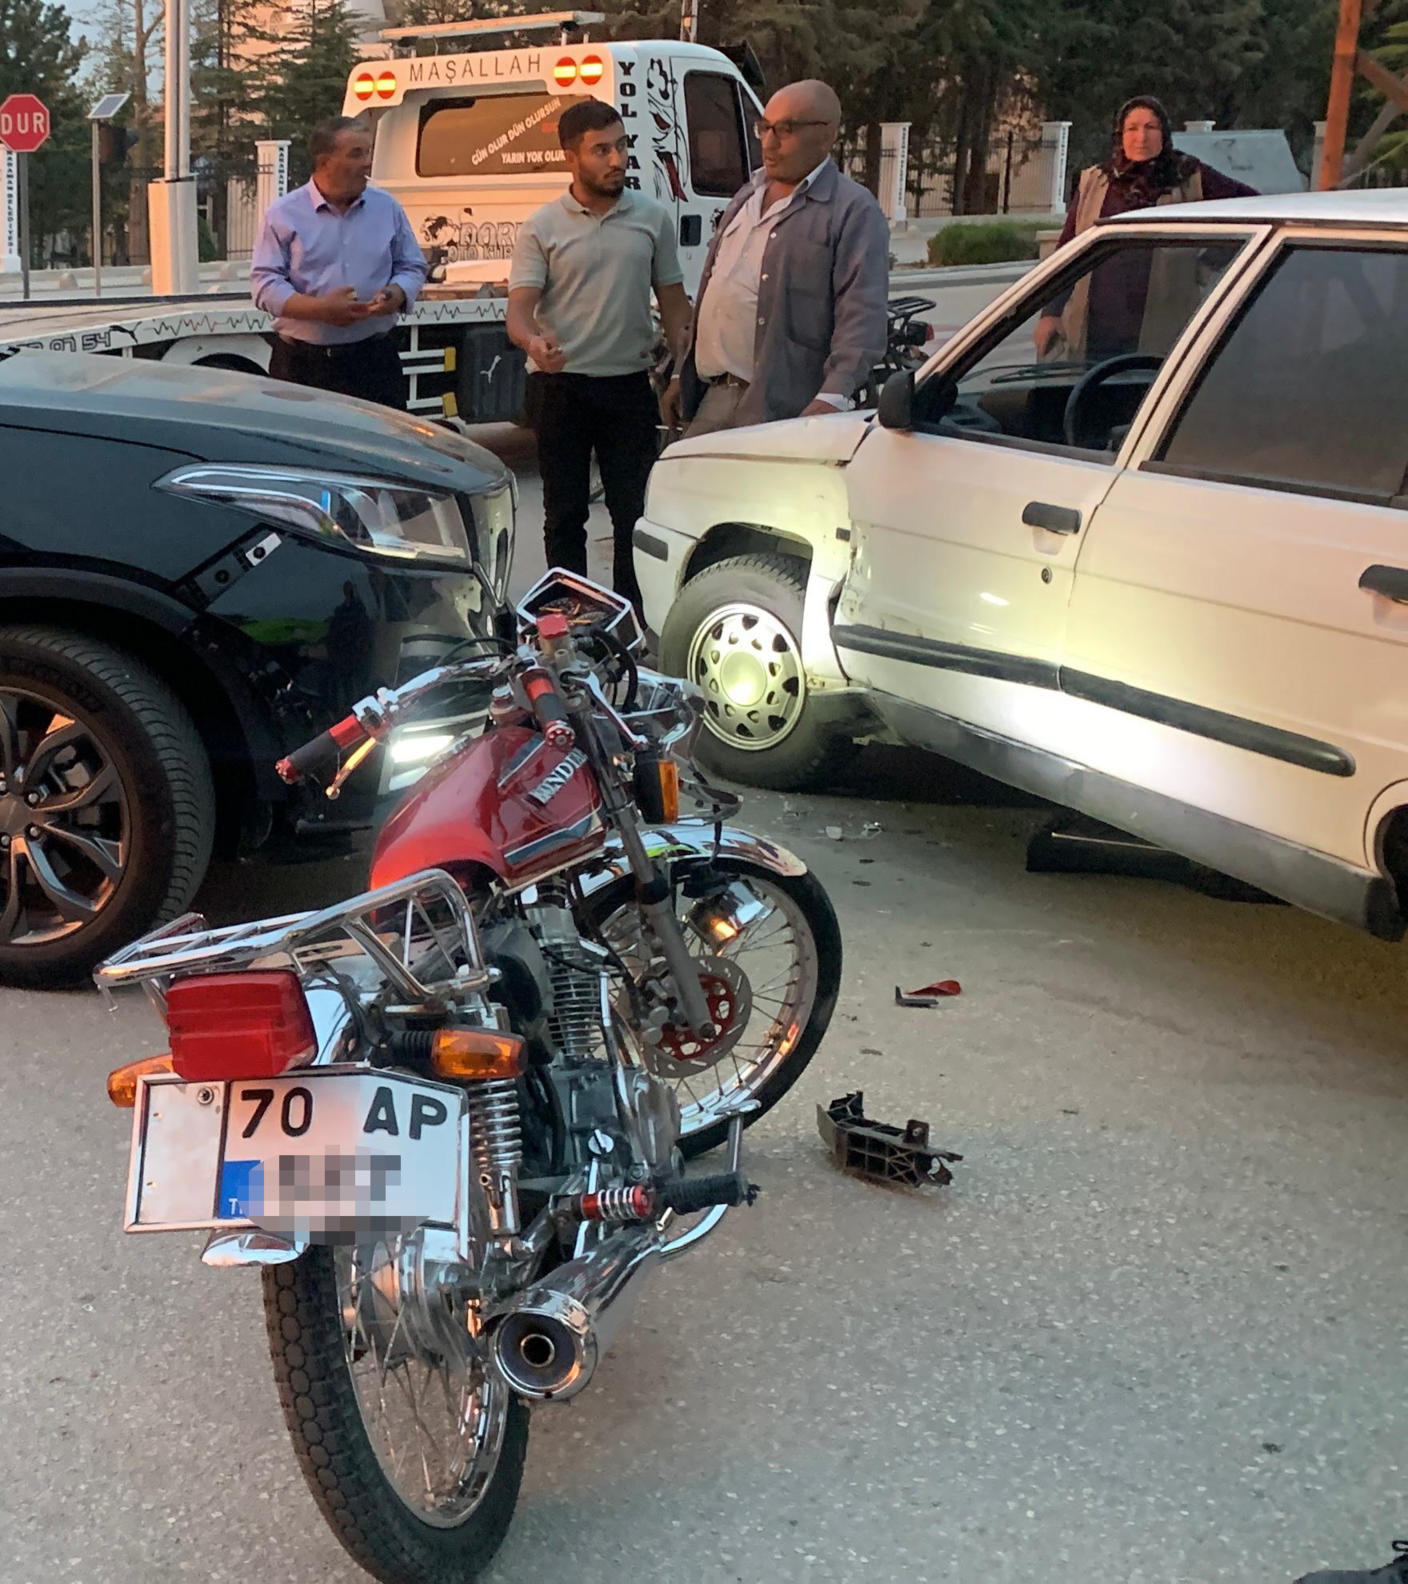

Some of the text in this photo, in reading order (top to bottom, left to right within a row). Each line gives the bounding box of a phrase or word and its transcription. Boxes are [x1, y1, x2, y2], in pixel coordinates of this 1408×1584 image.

[409, 53, 541, 84] MAŞALLAH
[617, 60, 638, 118] YOL
[0, 111, 45, 135] DUR
[472, 96, 562, 165] GÜN OLUR DÜN OLURSUN
[501, 151, 525, 164] YARIN
[526, 151, 543, 163] YOK
[81, 331, 111, 351] 54
[241, 1086, 448, 1141] 70 AP
